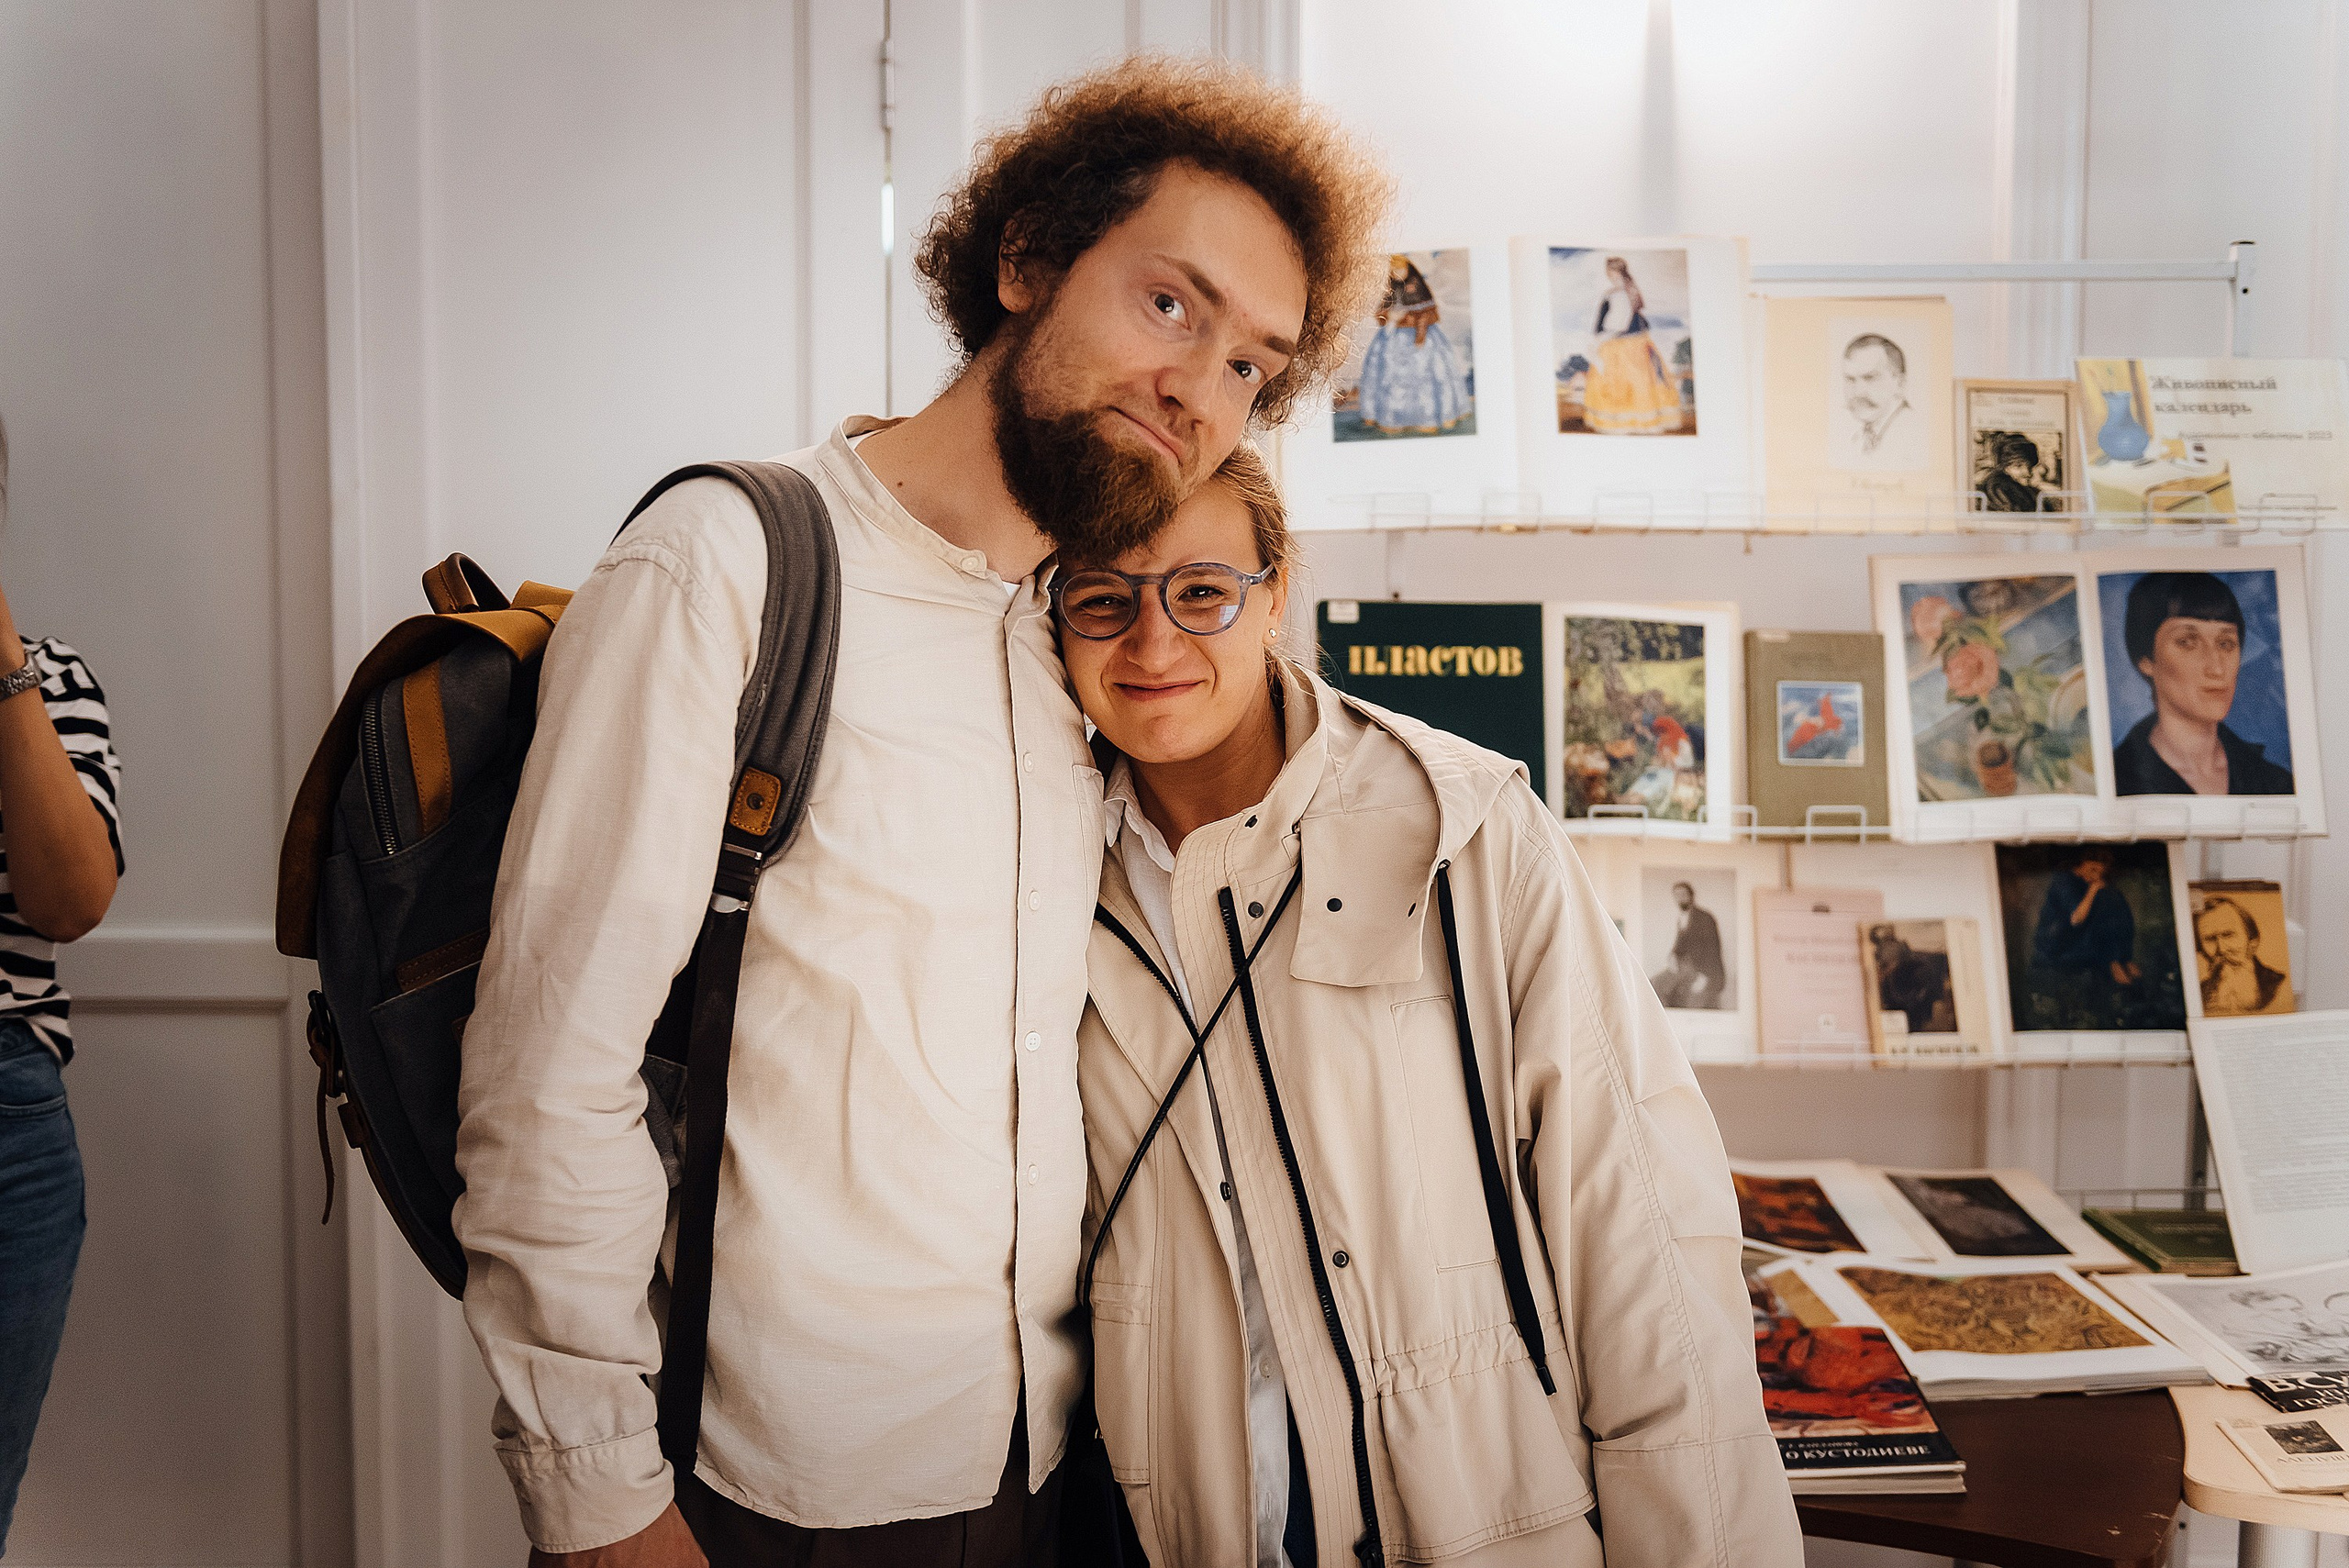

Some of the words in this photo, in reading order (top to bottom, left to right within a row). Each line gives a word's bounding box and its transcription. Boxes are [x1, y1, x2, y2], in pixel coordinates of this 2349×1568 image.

[2259, 1375, 2349, 1393] В.СУ
[1803, 1444, 1932, 1461] КУСТОДИЕВЕ
[2277, 1455, 2349, 1463] АЛЕНУШ
